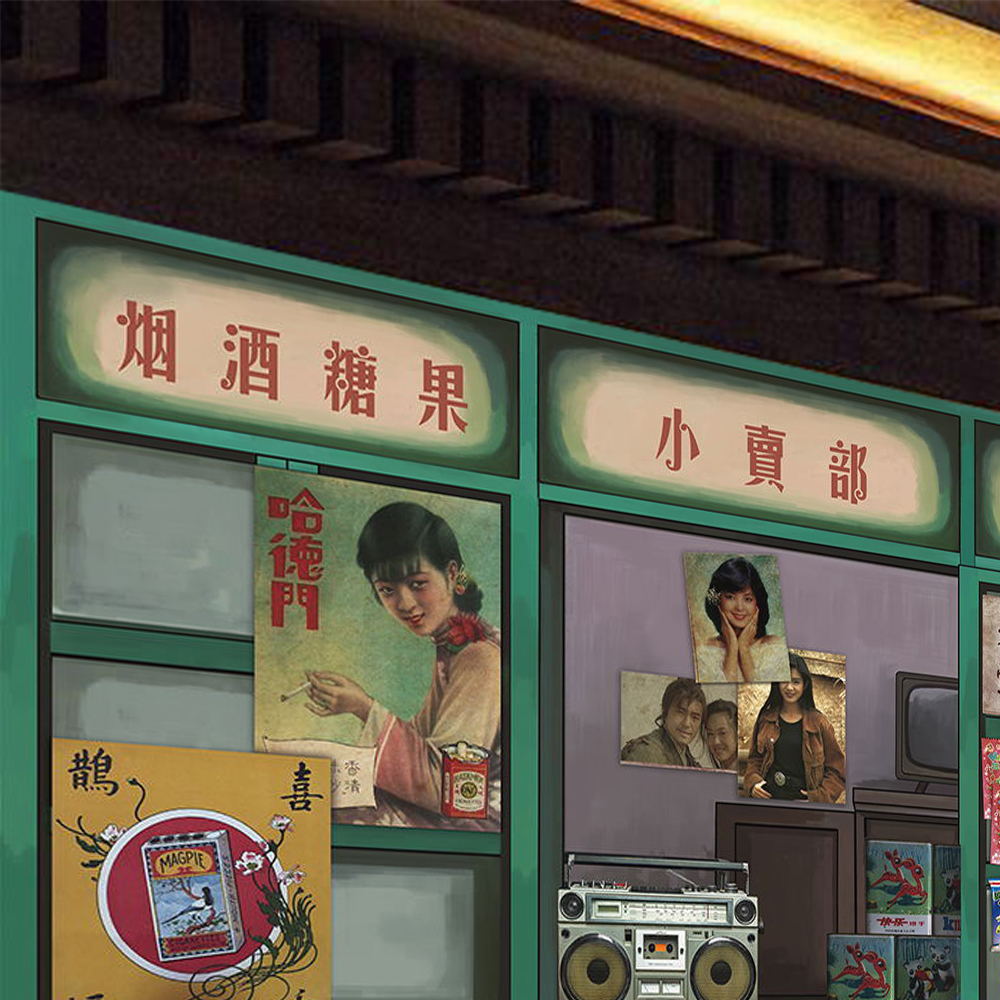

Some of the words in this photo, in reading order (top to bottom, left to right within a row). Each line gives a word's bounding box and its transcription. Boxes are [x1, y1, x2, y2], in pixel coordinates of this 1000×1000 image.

[116, 300, 468, 433] 烟酒糖果
[656, 408, 868, 504] 小賣部
[280, 761, 324, 812] 喜
[159, 850, 207, 874] MAGPIE
